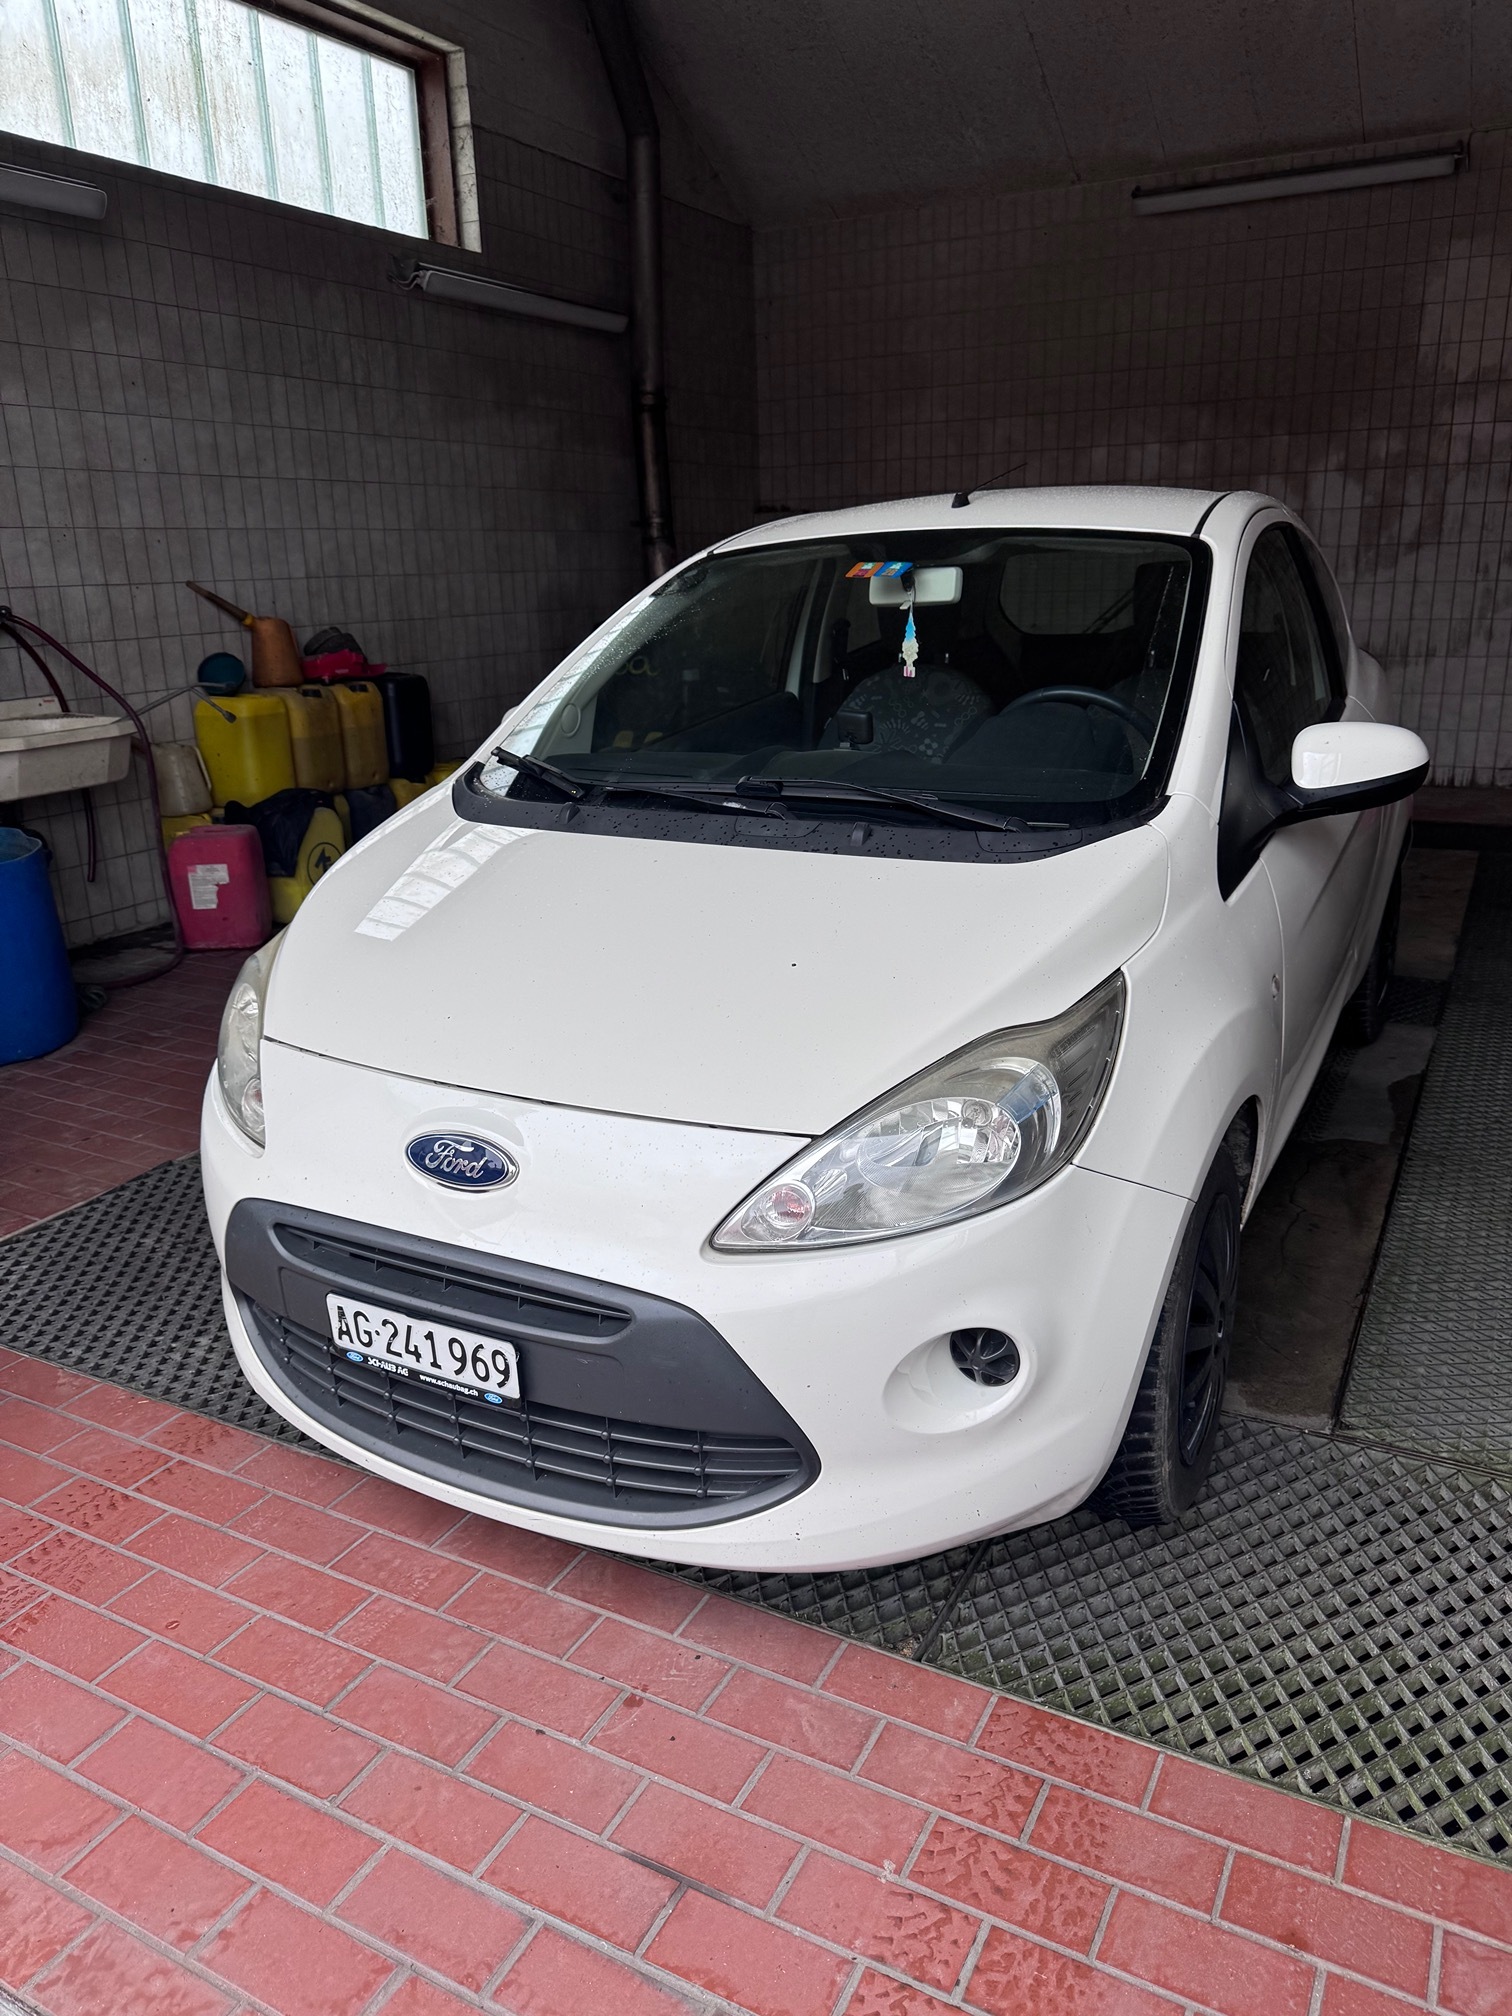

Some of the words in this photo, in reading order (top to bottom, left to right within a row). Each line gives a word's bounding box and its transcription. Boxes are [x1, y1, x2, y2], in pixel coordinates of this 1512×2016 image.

[425, 1139, 488, 1179] Ford
[397, 1366, 409, 1377] AG
[419, 1374, 479, 1397] www.schaubag.ch
